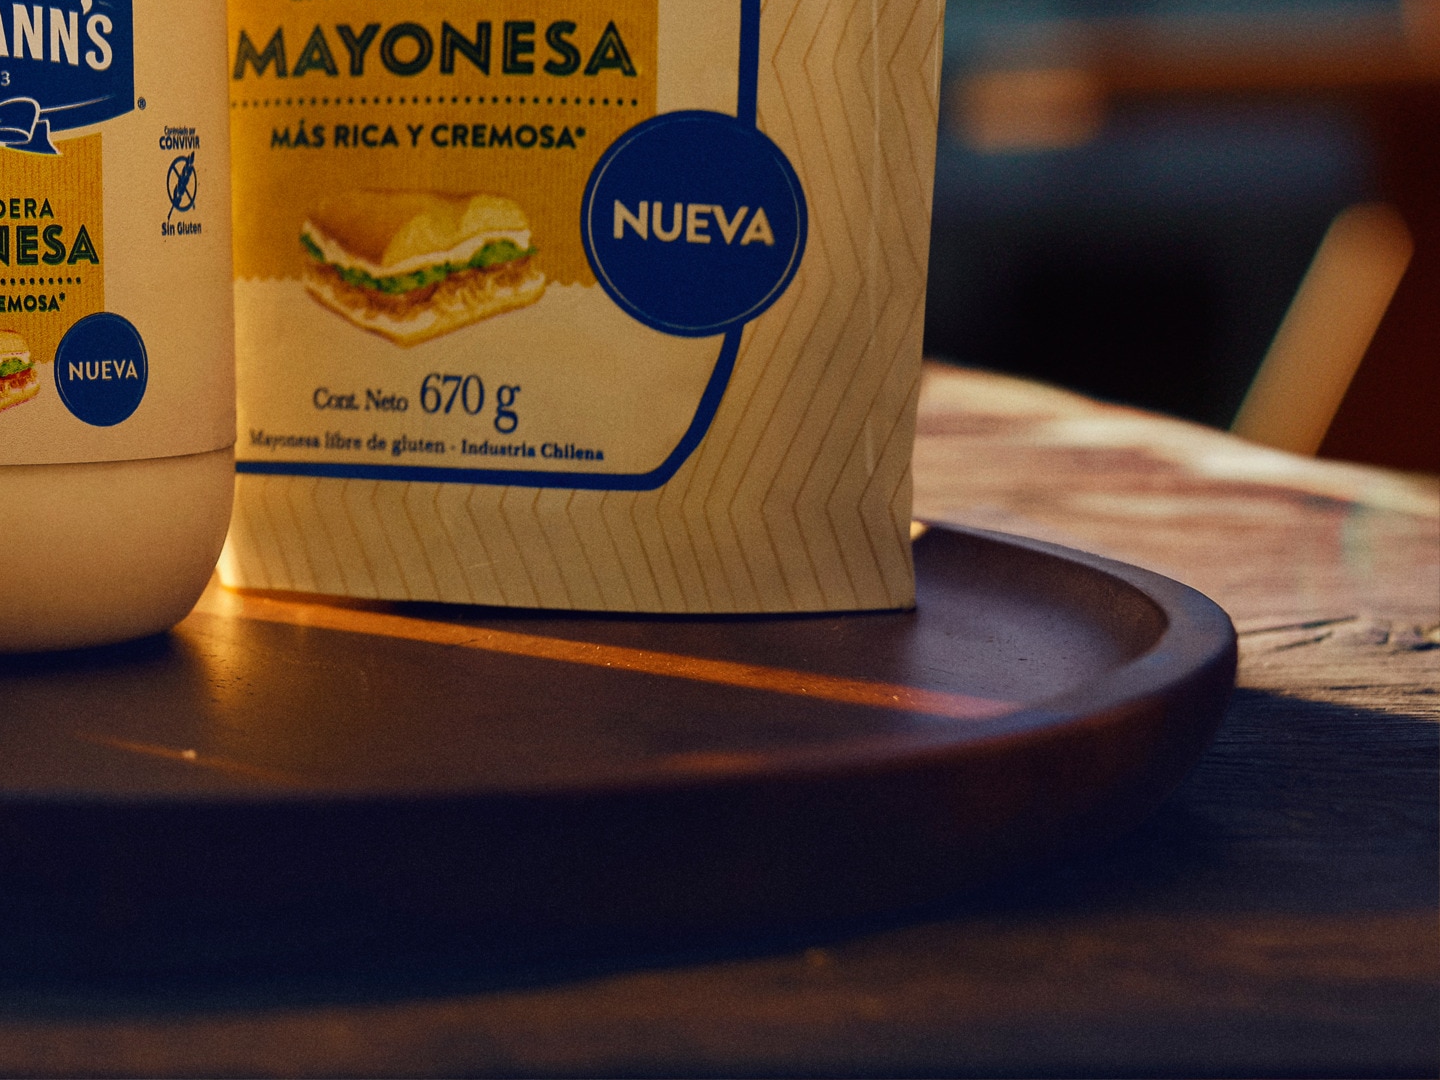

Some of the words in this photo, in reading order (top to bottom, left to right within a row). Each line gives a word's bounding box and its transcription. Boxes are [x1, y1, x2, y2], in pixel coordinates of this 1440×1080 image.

[232, 20, 638, 81] MAYONESA
[159, 135, 201, 150] CONVIVIR
[270, 118, 326, 150] MÁS
[333, 125, 400, 148] RICA
[406, 124, 421, 148] Y
[161, 222, 175, 236] Sin
[177, 223, 202, 235] Gluten
[612, 200, 776, 246] NUEVA
[68, 359, 138, 381] NUEVA
[313, 387, 359, 412] Cont.
[364, 389, 410, 413] Neto
[420, 373, 485, 416] 670
[493, 383, 521, 434] g
[367, 433, 387, 451] de
[391, 436, 446, 456] gluten
[462, 439, 536, 458] Industria
[541, 443, 605, 461] Chilena
